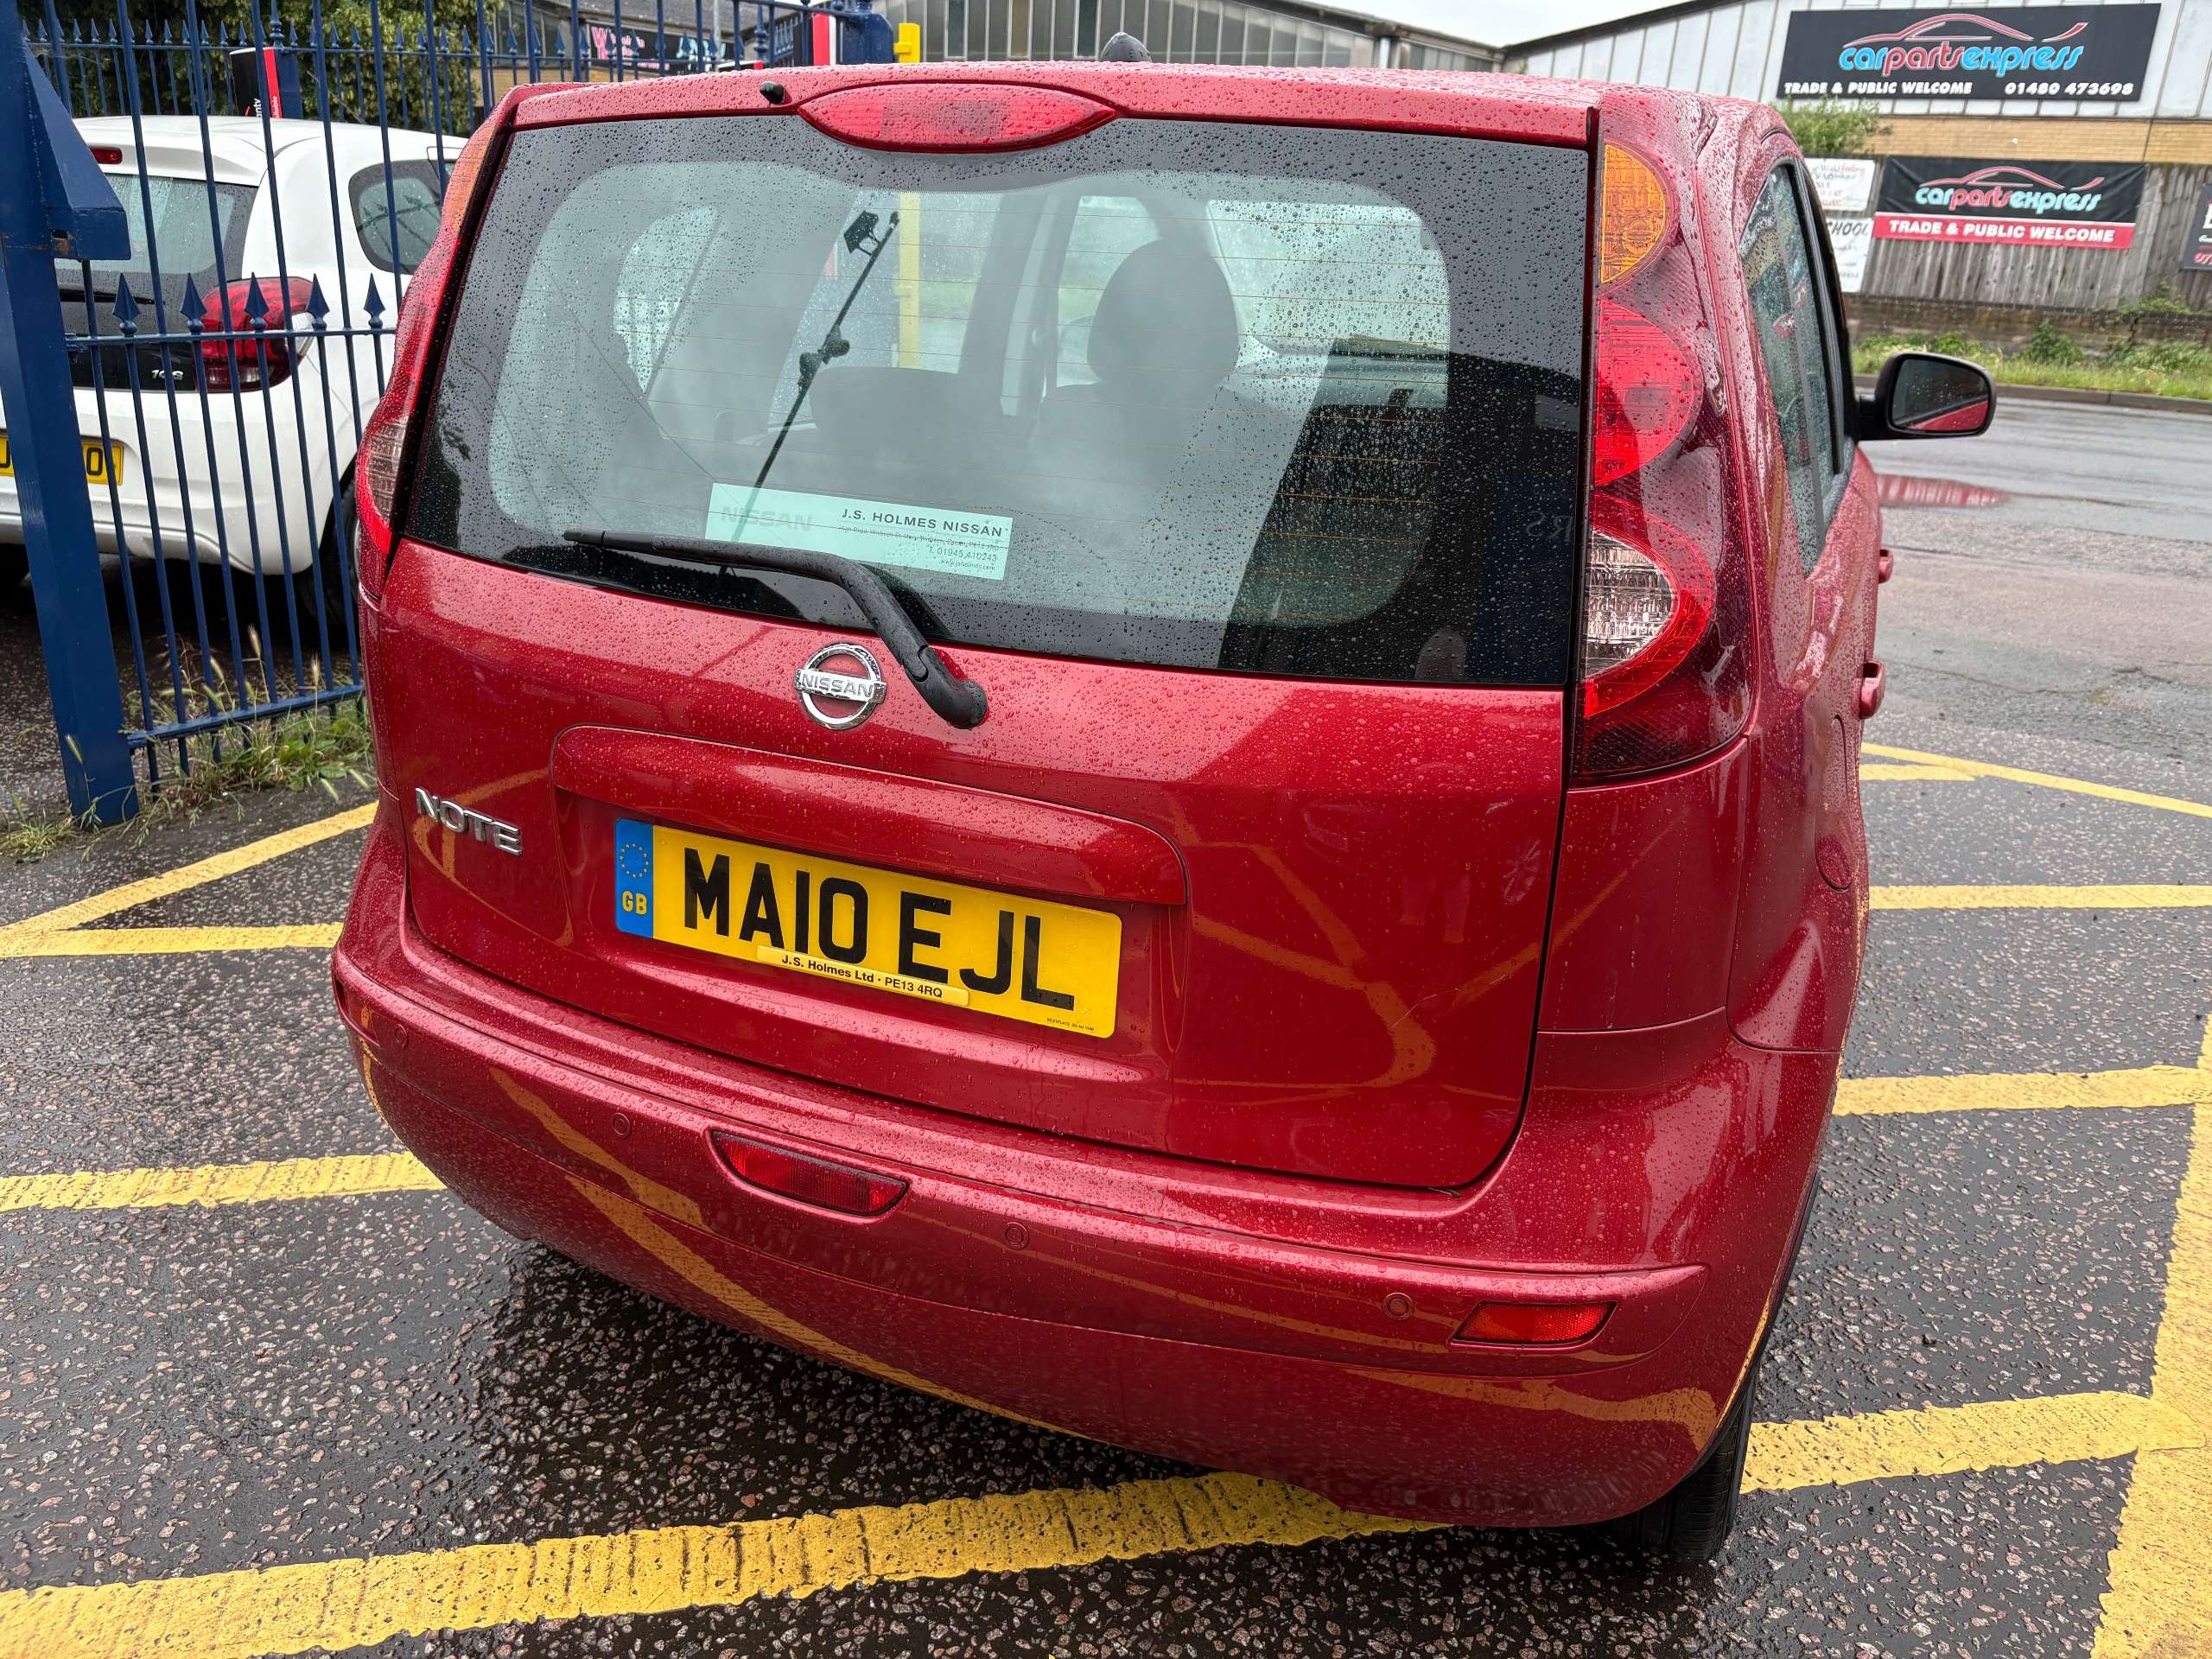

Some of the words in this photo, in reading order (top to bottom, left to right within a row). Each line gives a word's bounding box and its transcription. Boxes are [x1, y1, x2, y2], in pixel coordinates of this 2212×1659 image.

[1839, 41, 2084, 78] carpartsexpress
[1784, 82, 1827, 94] TRADE
[1831, 82, 1843, 94] &
[1847, 82, 1897, 94] PUBLIC
[1902, 82, 1973, 95] WELCOME
[2005, 82, 2061, 95] 01480
[2064, 82, 2133, 95] 473698
[1915, 186, 2101, 214] carpartsexpress
[1889, 220, 1942, 234] TRADE
[1946, 222, 1958, 235] &
[1963, 225, 2024, 238] PUBLIC
[2031, 227, 2115, 242] WELCOME
[842, 508, 866, 520] J.S.
[873, 512, 937, 529] HOLMES
[943, 520, 1002, 537] NISSAN
[937, 547, 963, 558] 01945
[966, 551, 997, 563] 410243
[802, 673, 874, 697] NISSAN
[415, 787, 523, 856] NOTE
[622, 890, 647, 915] GB
[899, 891, 1074, 1011] EJL
[782, 955, 804, 967] J.S.
[808, 960, 851, 978] Holmes
[855, 969, 874, 982] Ltd
[885, 976, 913, 992] PE13
[918, 984, 943, 999] 4RQ
